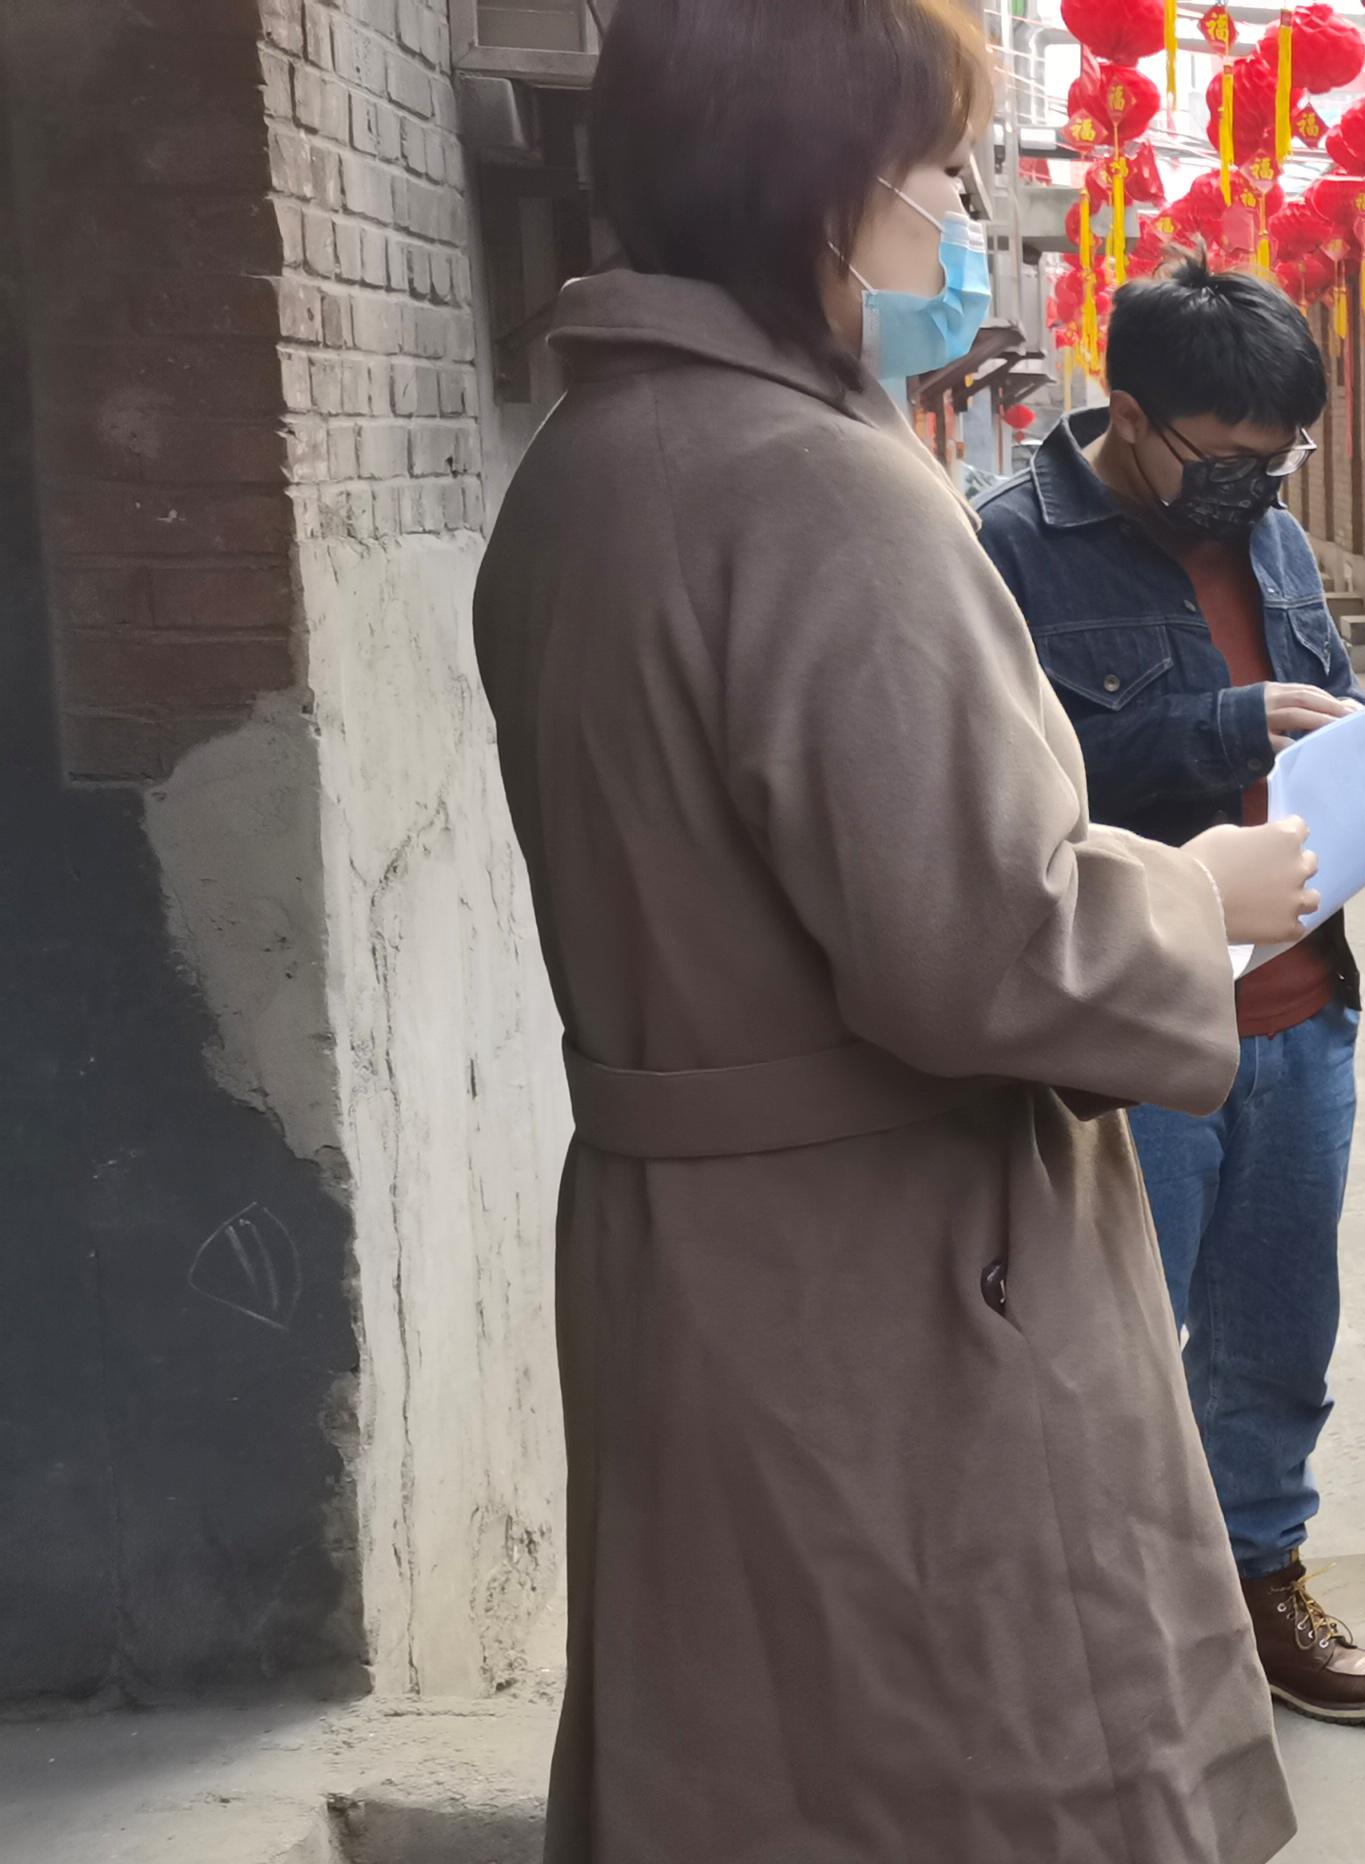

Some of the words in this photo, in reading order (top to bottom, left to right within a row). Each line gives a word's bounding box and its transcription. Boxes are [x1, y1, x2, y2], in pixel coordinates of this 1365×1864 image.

[1206, 12, 1228, 42] 福
[1071, 117, 1096, 142] 福
[1297, 112, 1319, 138] 福
[1250, 157, 1274, 180] 福
